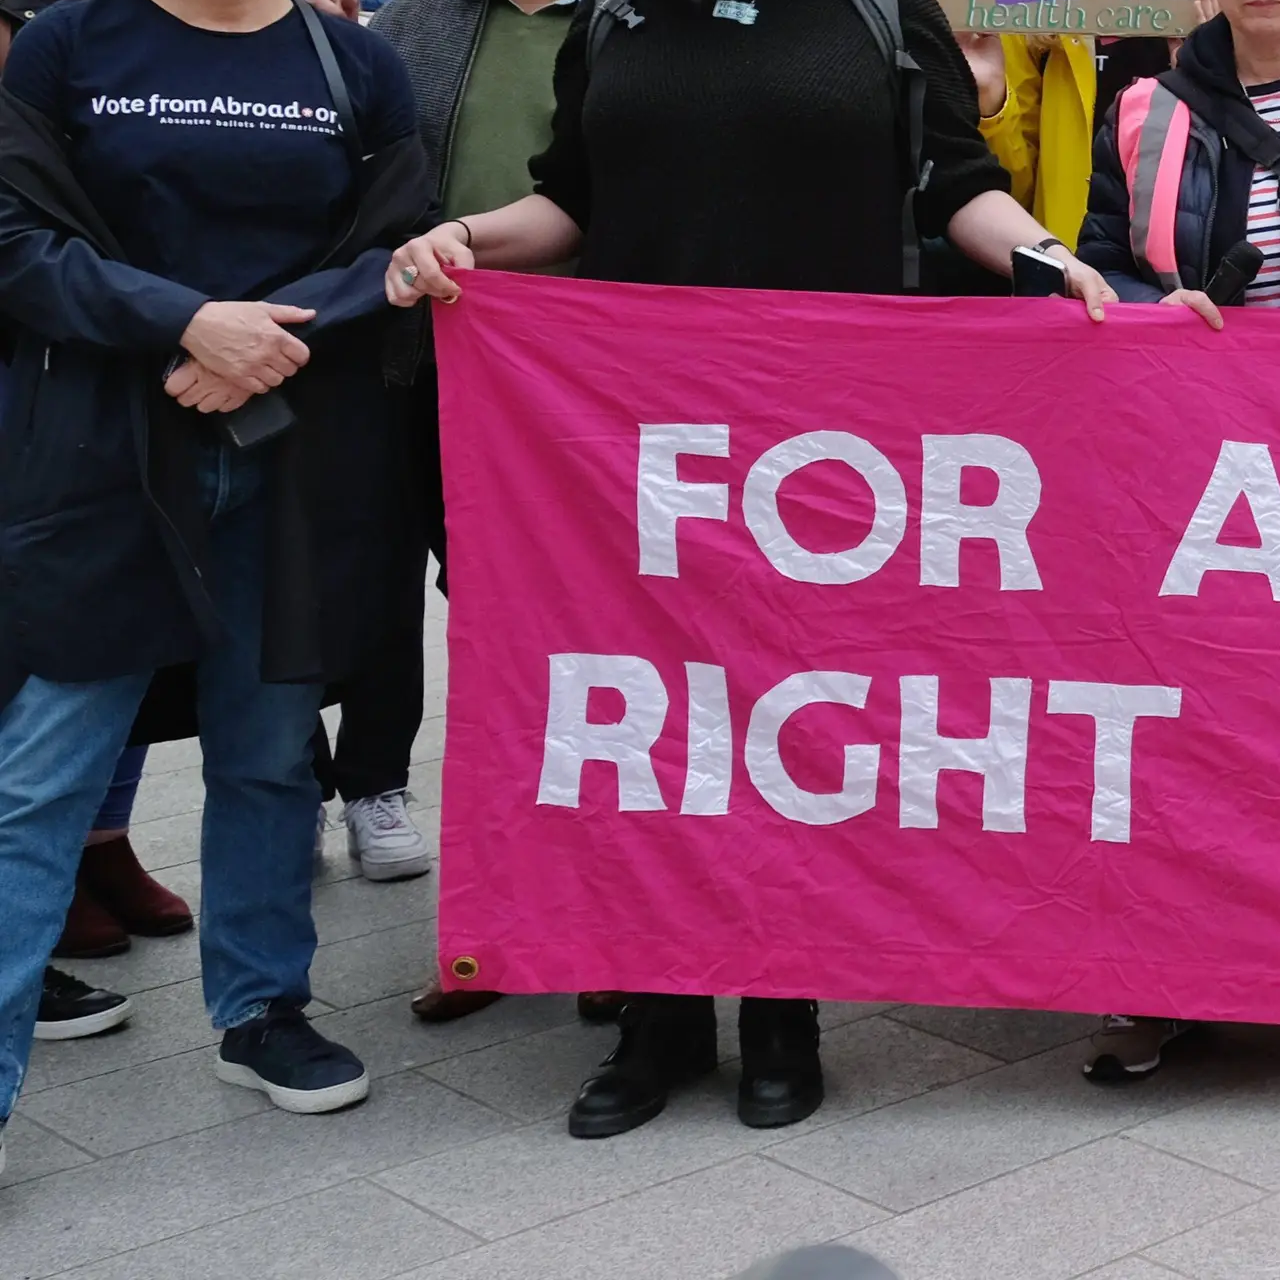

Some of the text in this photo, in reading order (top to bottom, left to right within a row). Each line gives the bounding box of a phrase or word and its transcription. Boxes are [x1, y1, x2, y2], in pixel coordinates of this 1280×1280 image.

[160, 117, 336, 136] Absentee ballots for Americans
[637, 423, 1044, 591] FOR
[535, 653, 1182, 843] RIGHT
